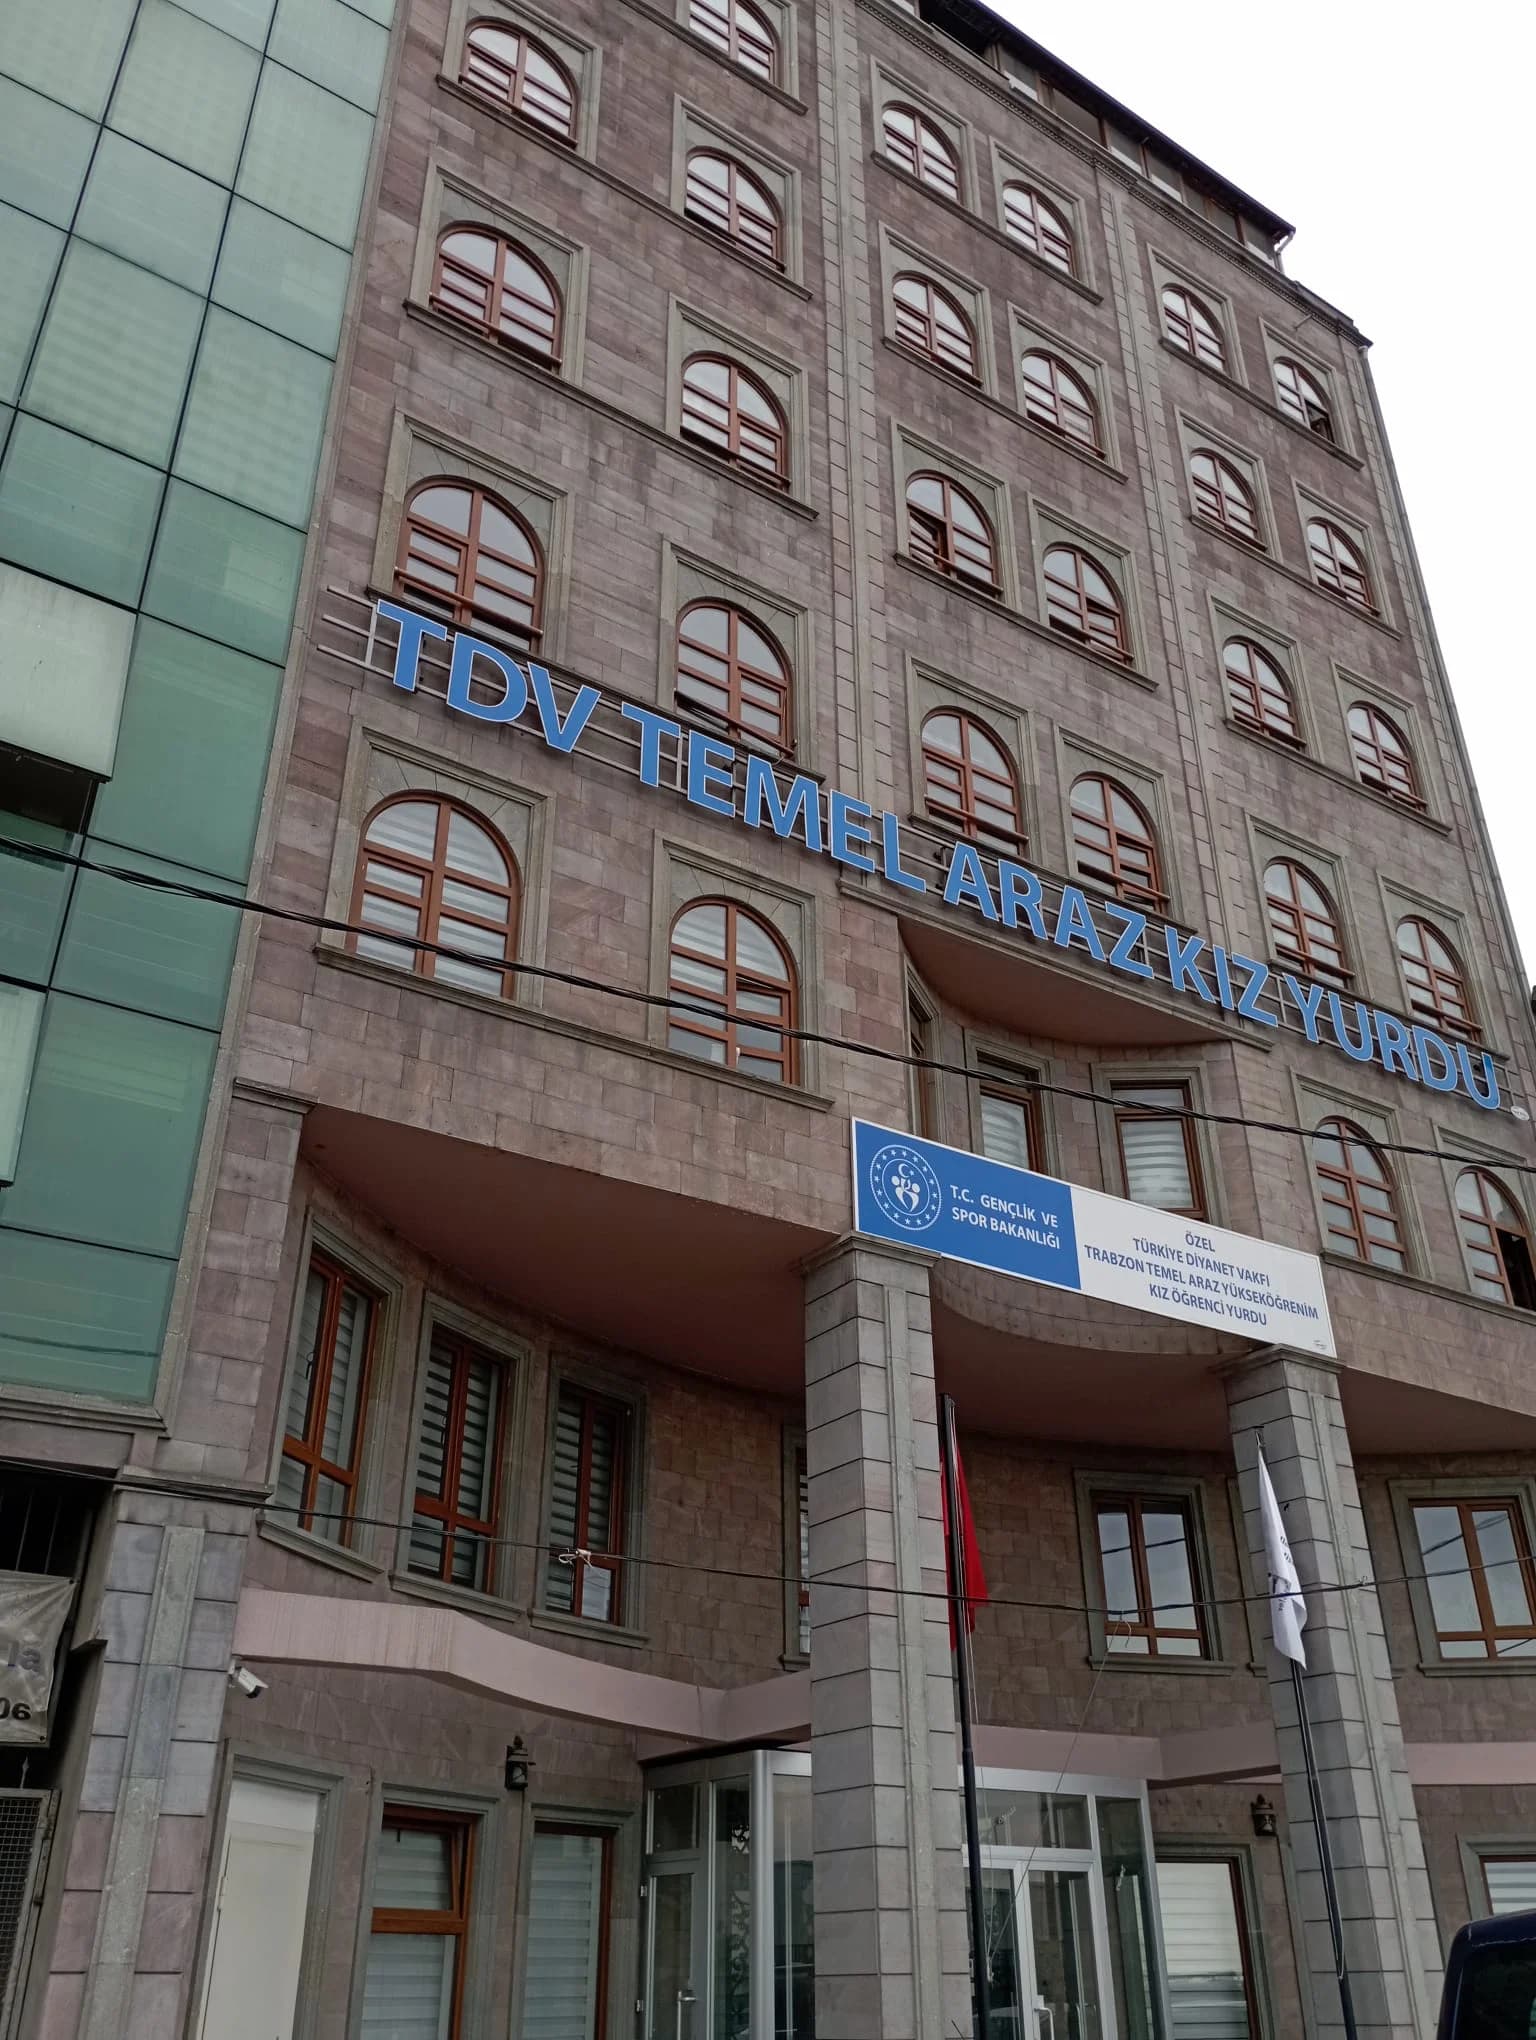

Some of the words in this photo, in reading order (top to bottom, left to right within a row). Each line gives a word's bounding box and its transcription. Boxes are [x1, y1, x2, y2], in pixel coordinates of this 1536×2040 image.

[377, 599, 602, 754] TDV
[621, 701, 927, 894] TEMEL
[943, 841, 1155, 980] ARAZ
[1165, 926, 1279, 1029] KIZ
[1285, 973, 1501, 1111] YURDU
[950, 1185, 974, 1204] T.C.
[980, 1195, 1036, 1222] GENÇLİK
[1041, 1211, 1058, 1228] VE
[952, 1207, 988, 1229] SPOR
[990, 1217, 1060, 1249] BAKANLIĞI
[1132, 1237, 1184, 1263] TÜRKİYE
[1186, 1251, 1234, 1277] DİYANET
[1237, 1267, 1270, 1287] VAKFI
[1185, 1230, 1215, 1252] ÖZEL
[1084, 1244, 1145, 1273] TRABZON
[1146, 1262, 1186, 1285] TEMEL
[1189, 1274, 1221, 1294] ARAZ
[1221, 1281, 1319, 1320] YÜKSEKÖĞRENİM
[1149, 1283, 1170, 1301] KIZ
[1171, 1287, 1225, 1315] ÖĞRENCİ
[1226, 1303, 1267, 1326] YURDU
